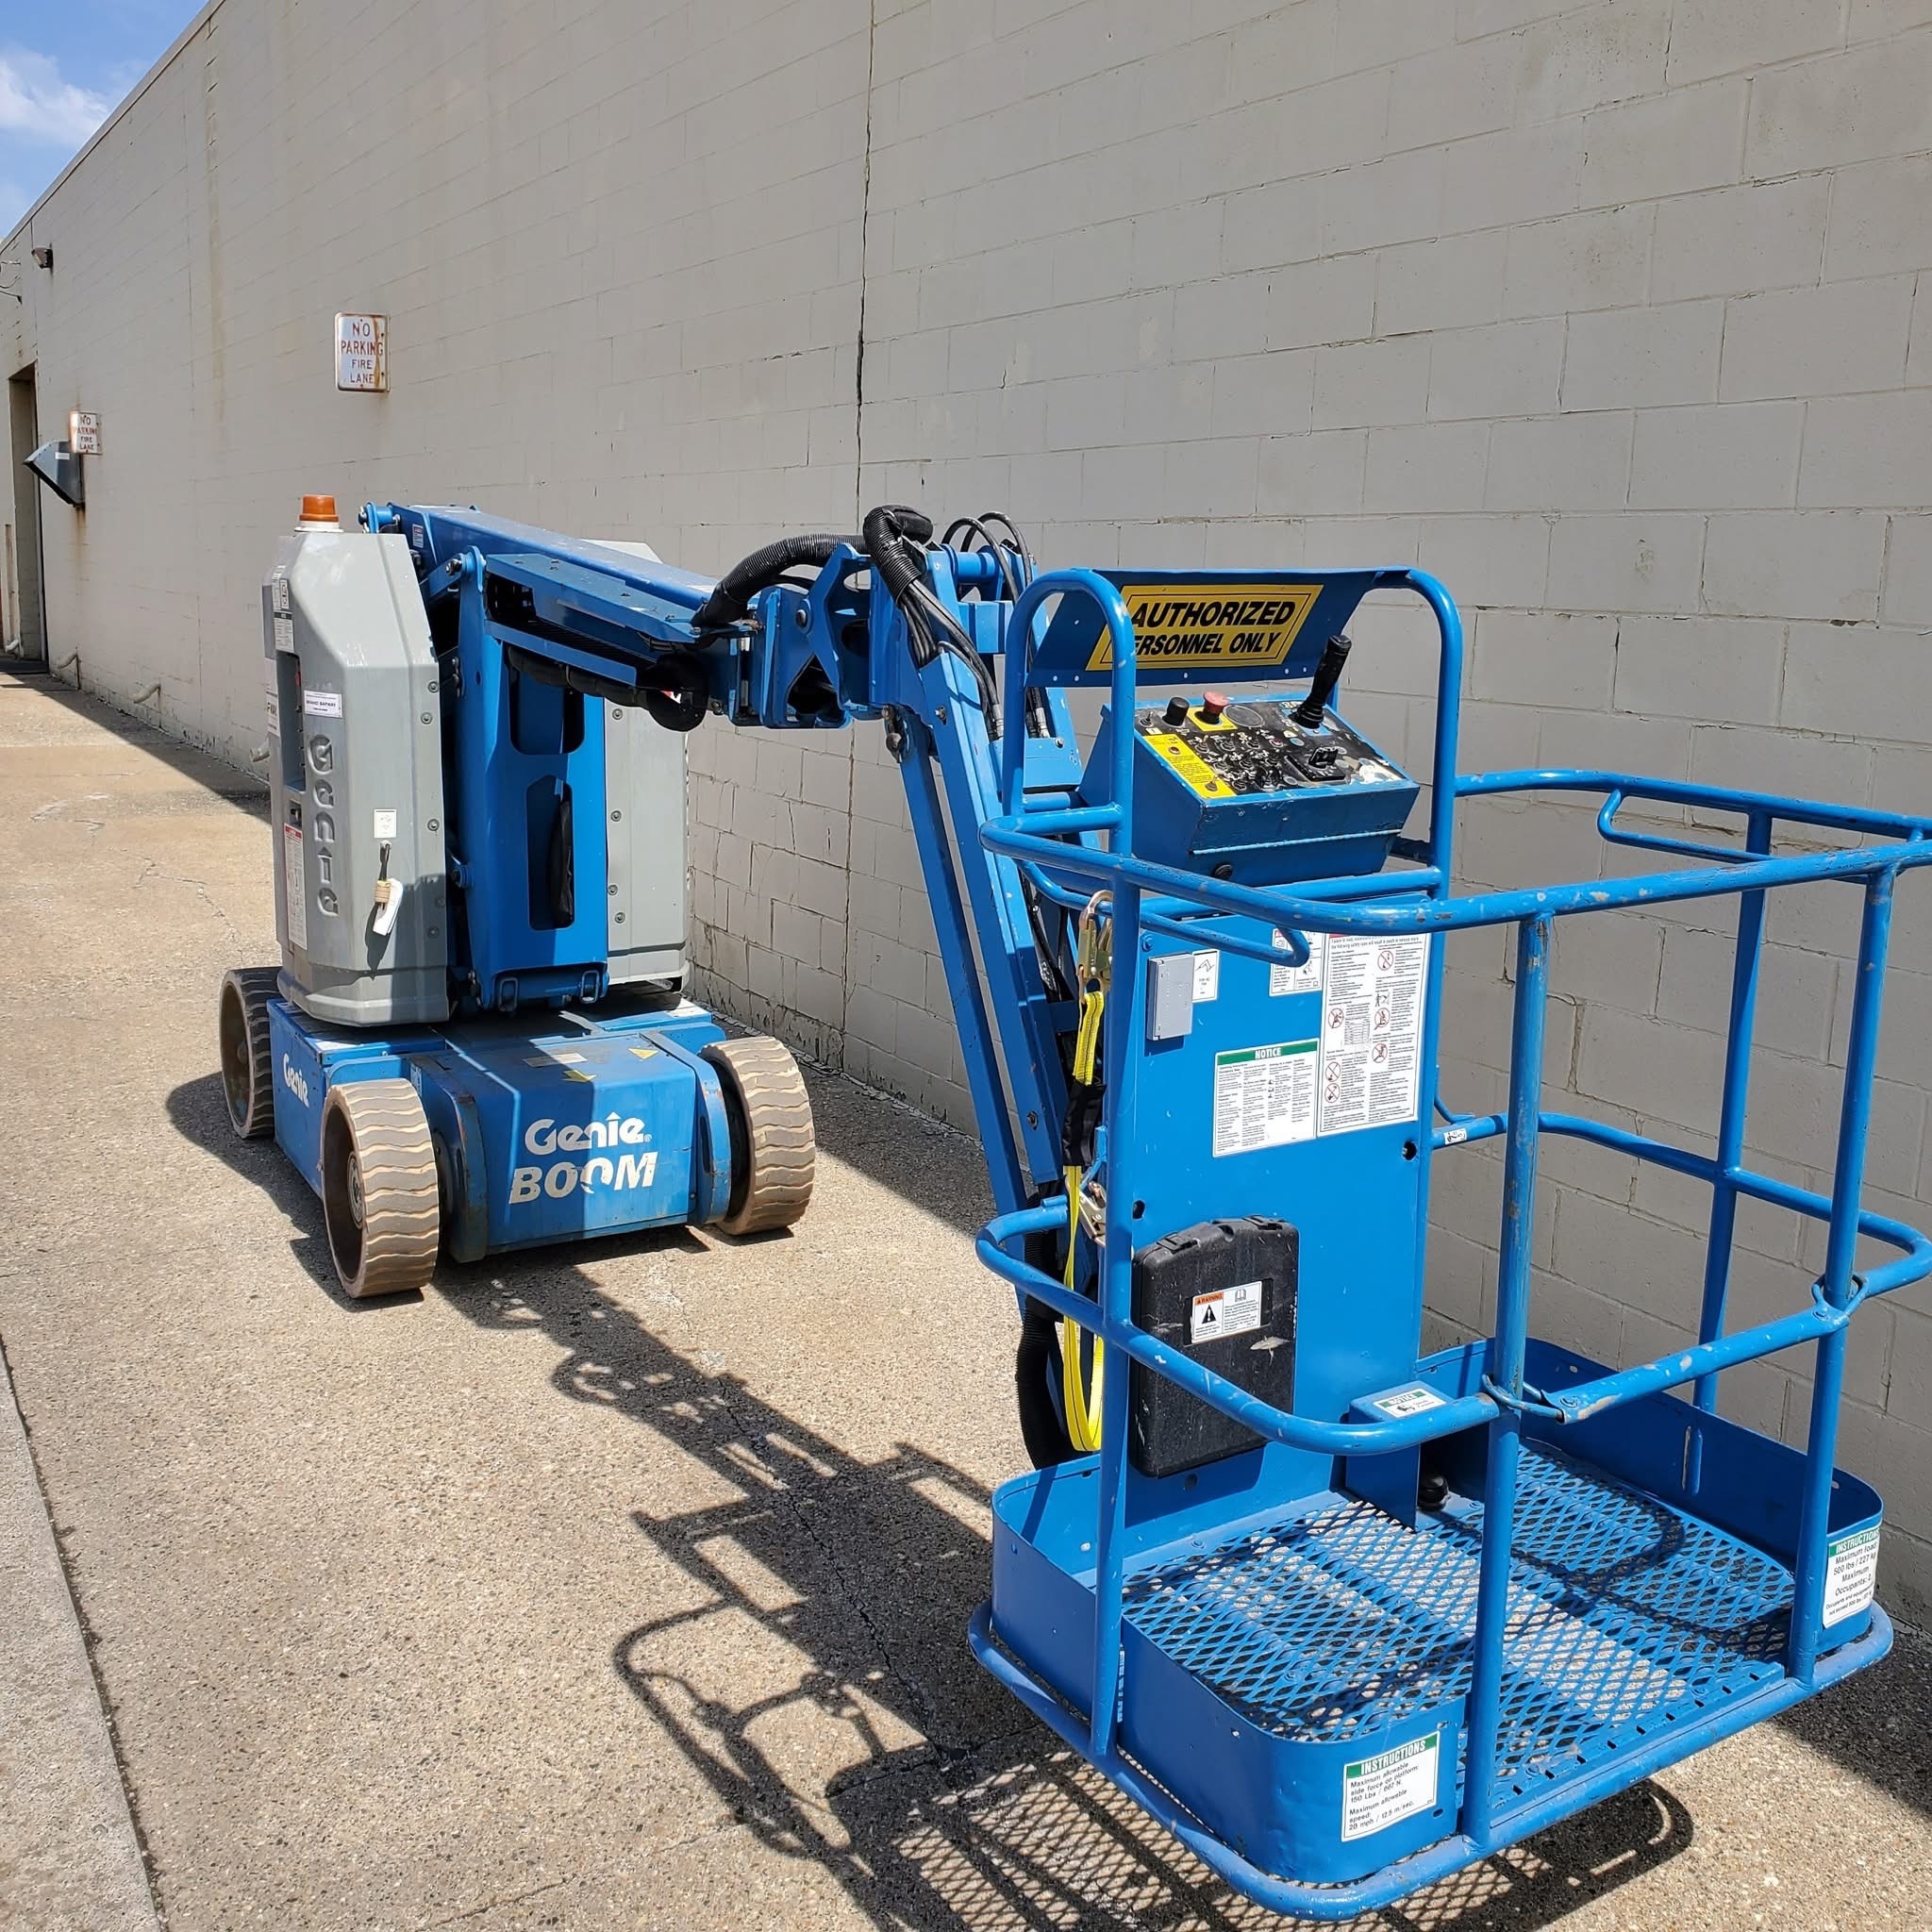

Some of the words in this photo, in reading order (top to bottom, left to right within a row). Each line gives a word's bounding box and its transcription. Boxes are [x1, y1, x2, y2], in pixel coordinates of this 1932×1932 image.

[353, 323, 371, 337] NO
[341, 341, 383, 356] PARKING
[352, 359, 373, 370] FIRE
[350, 373, 375, 384] LANE
[80, 416, 91, 425] NO
[1132, 601, 1296, 628] AUTHORIZED
[1134, 633, 1224, 657] ERSONNEL
[1229, 632, 1282, 654] ONLY
[1255, 1047, 1282, 1059] NOTICE
[283, 1053, 309, 1108] Genie
[525, 1111, 646, 1156] Genie
[508, 1151, 658, 1205] BOOM
[1833, 1565, 1845, 1575] 500
[1858, 1554, 1869, 1565] 227
[1835, 1547, 1863, 1564] Maximum
[1841, 1566, 1869, 1583] Maximum
[1360, 1740, 1425, 1775] INSTRUCTIONS
[1350, 1775, 1381, 1789] Maximum
[1383, 1762, 1408, 1778] allowable
[1351, 1786, 1365, 1796] side
[1367, 1781, 1383, 1791] force
[1351, 1794, 1363, 1804] 150
[1364, 1791, 1376, 1800] Lbs
[1349, 1802, 1379, 1816] Maximum
[1381, 1789, 1407, 1805] allowable
[1349, 1823, 1358, 1831] 28
[1359, 1818, 1374, 1828] mph
[1381, 1808, 1393, 1819] 12.5
